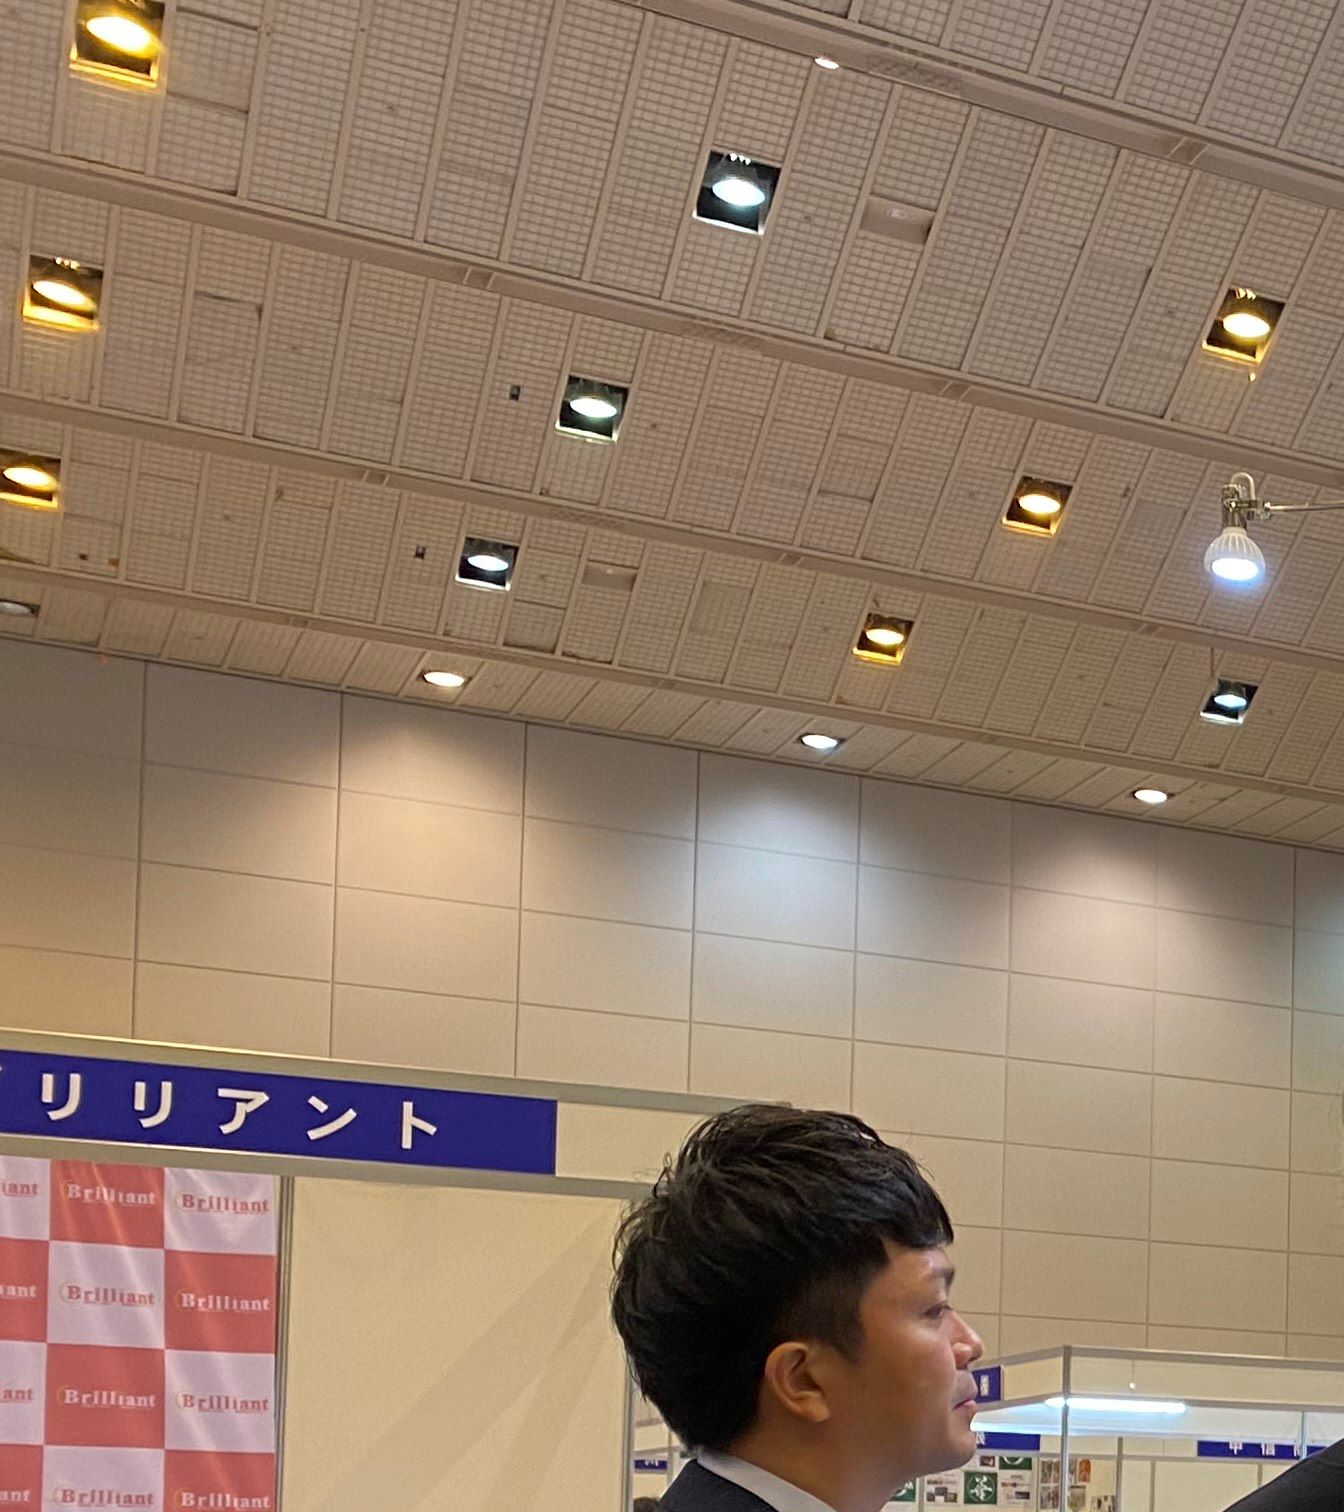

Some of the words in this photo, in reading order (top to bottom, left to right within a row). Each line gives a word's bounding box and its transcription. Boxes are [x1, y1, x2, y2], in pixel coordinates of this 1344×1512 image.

[0, 1066, 437, 1149] リリアント
[67, 1183, 155, 1204] Brilliant
[182, 1193, 268, 1212] Brilliant
[67, 1284, 154, 1305] Brilliant
[181, 1292, 270, 1311] Brilliant
[64, 1388, 155, 1407] Brilliant
[182, 1394, 268, 1412] Brilliant
[60, 1489, 154, 1507] Brilliant
[181, 1492, 270, 1509] Brilliant
